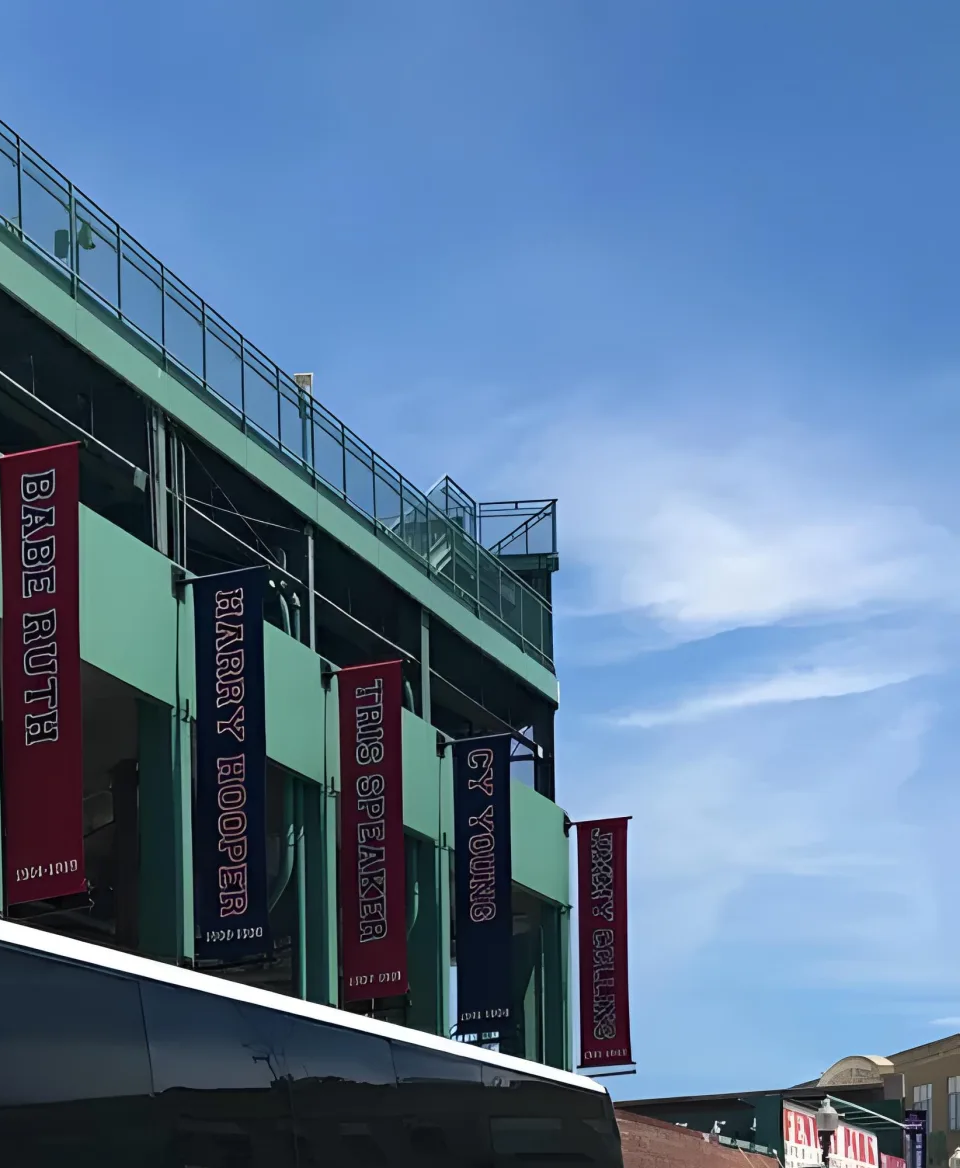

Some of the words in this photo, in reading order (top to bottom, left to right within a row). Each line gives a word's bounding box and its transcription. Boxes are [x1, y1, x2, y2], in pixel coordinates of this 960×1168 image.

[21, 468, 56, 599] BABE
[22, 608, 59, 746] RUTH
[215, 587, 246, 742] HARRY
[355, 678, 385, 766] TRIS
[217, 753, 248, 918] HOOPER
[467, 748, 495, 797] CY
[356, 773, 388, 944] SPEAKER
[468, 804, 497, 923] YOUNG
